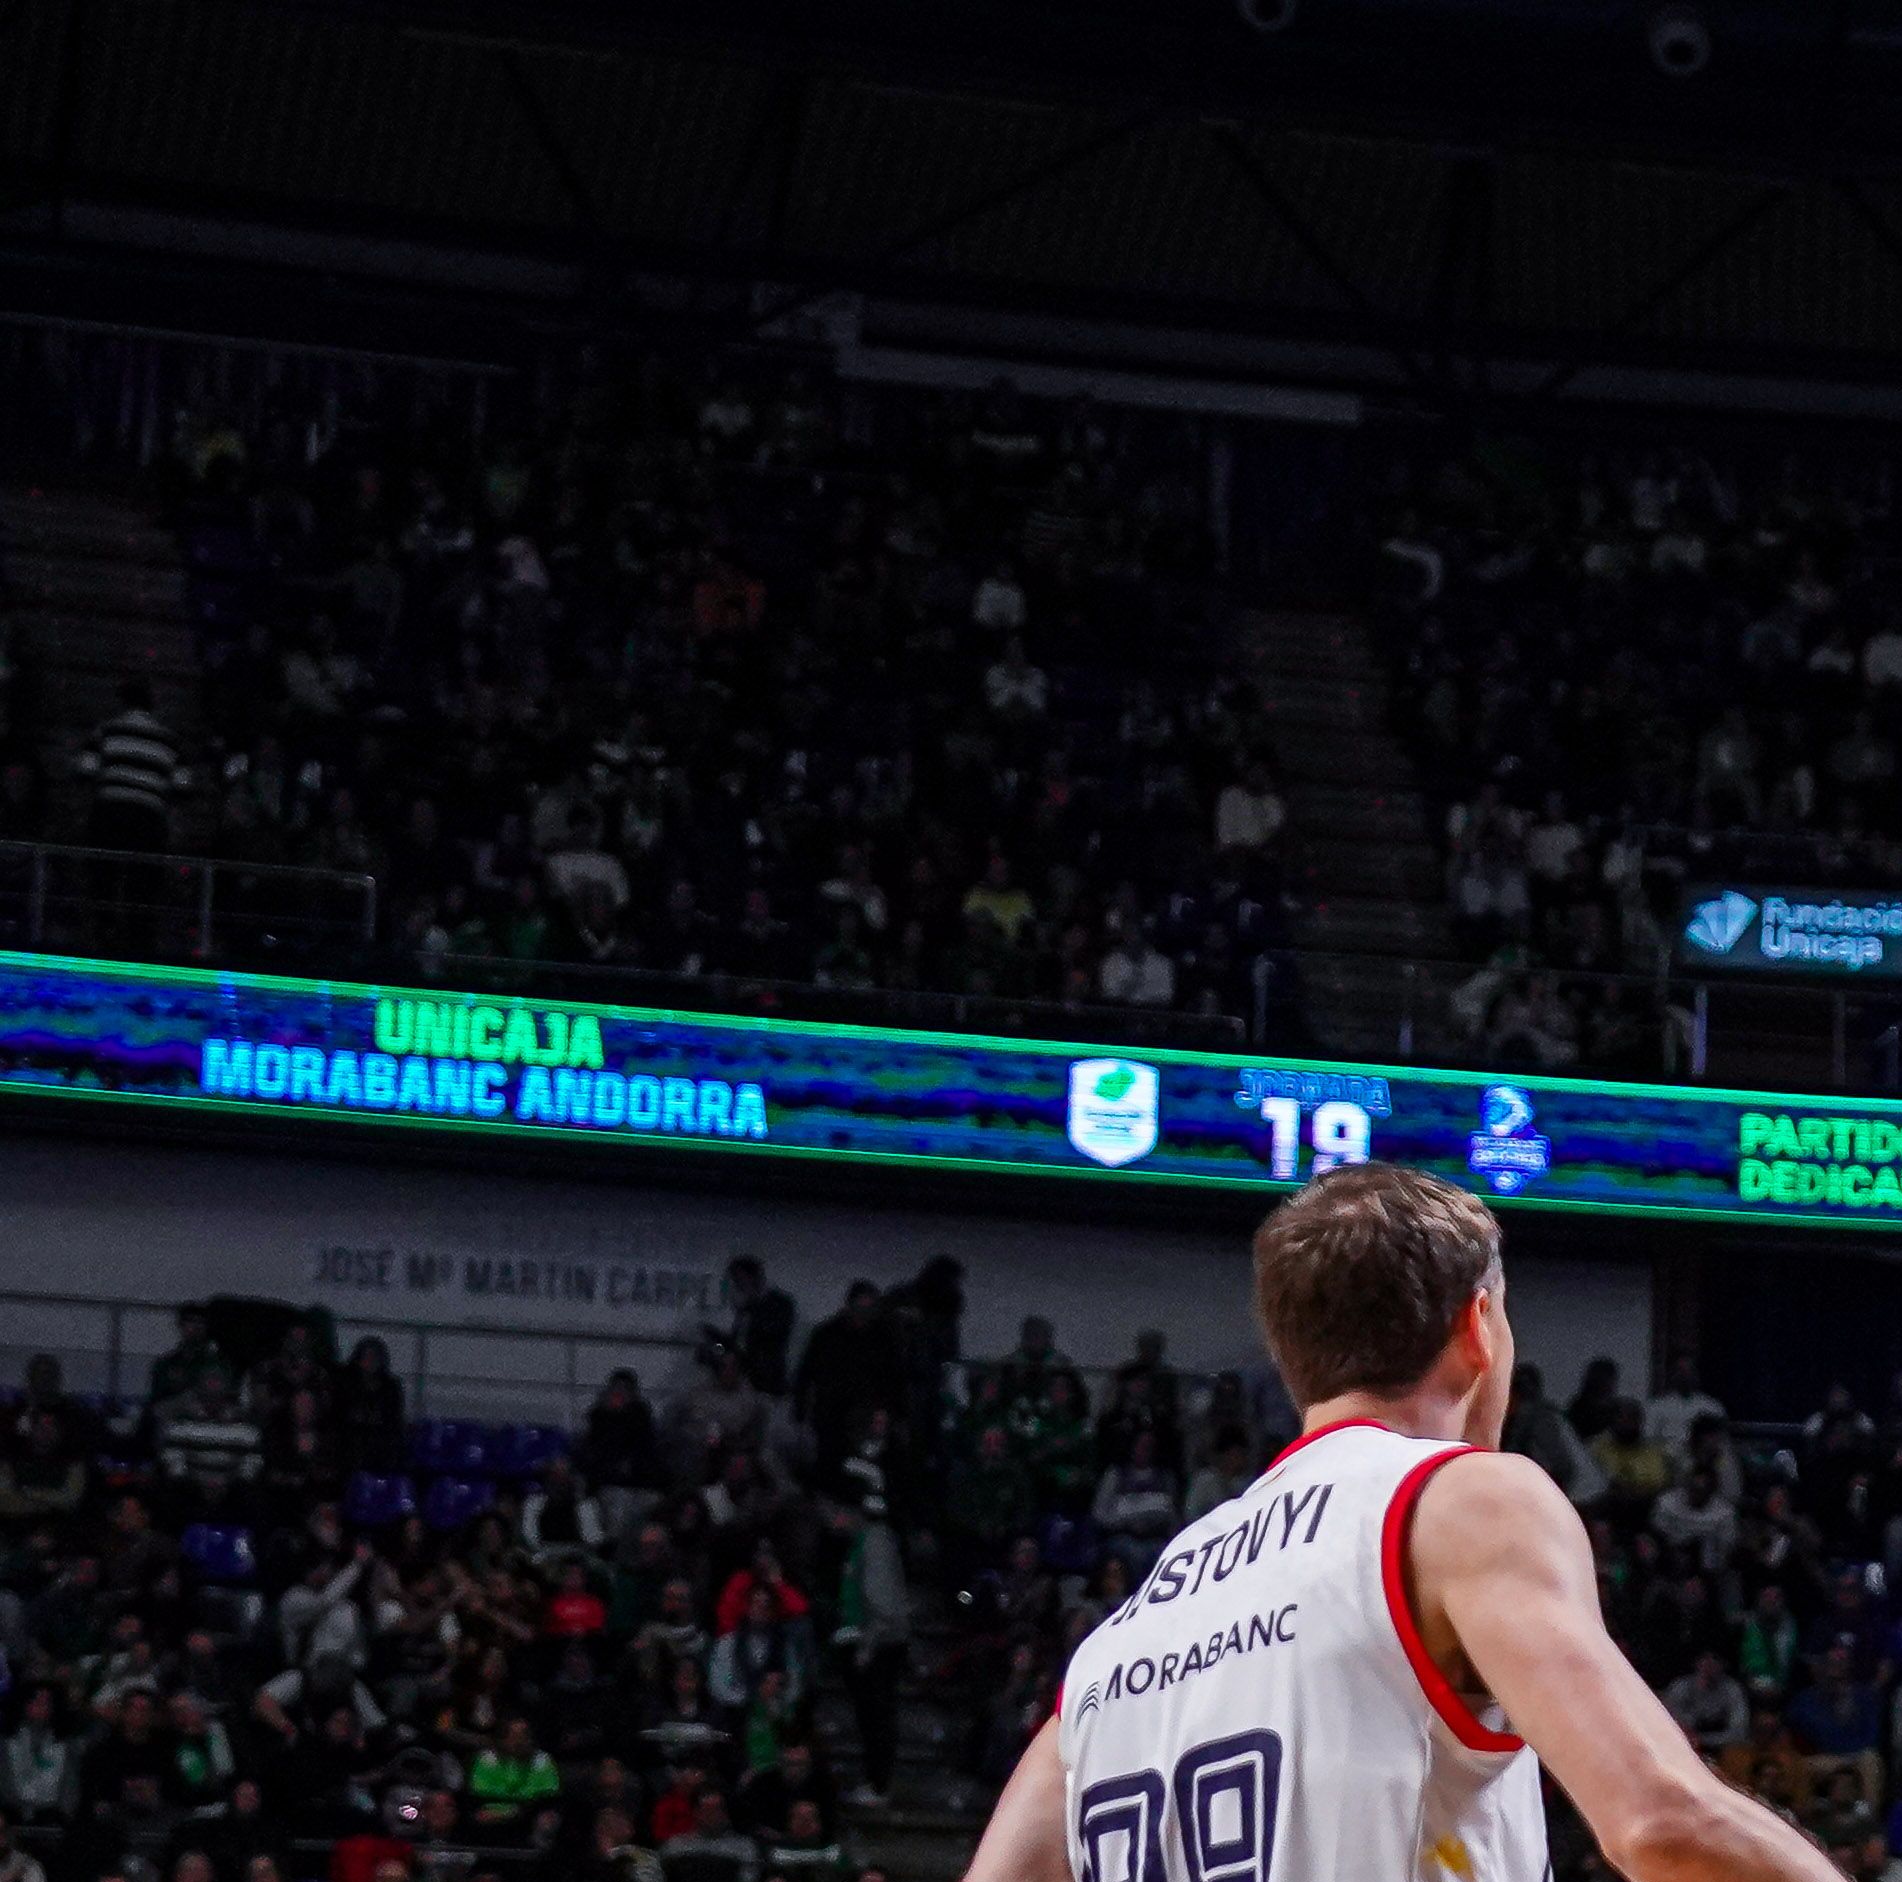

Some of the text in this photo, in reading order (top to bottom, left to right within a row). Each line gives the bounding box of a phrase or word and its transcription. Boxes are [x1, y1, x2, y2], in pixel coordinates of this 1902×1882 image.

[1761, 926, 1884, 971] Unicaja
[374, 999, 605, 1069] UNICAJA
[200, 1038, 769, 1140] MORABANC ANDORRA
[1260, 1097, 1372, 1180] 19
